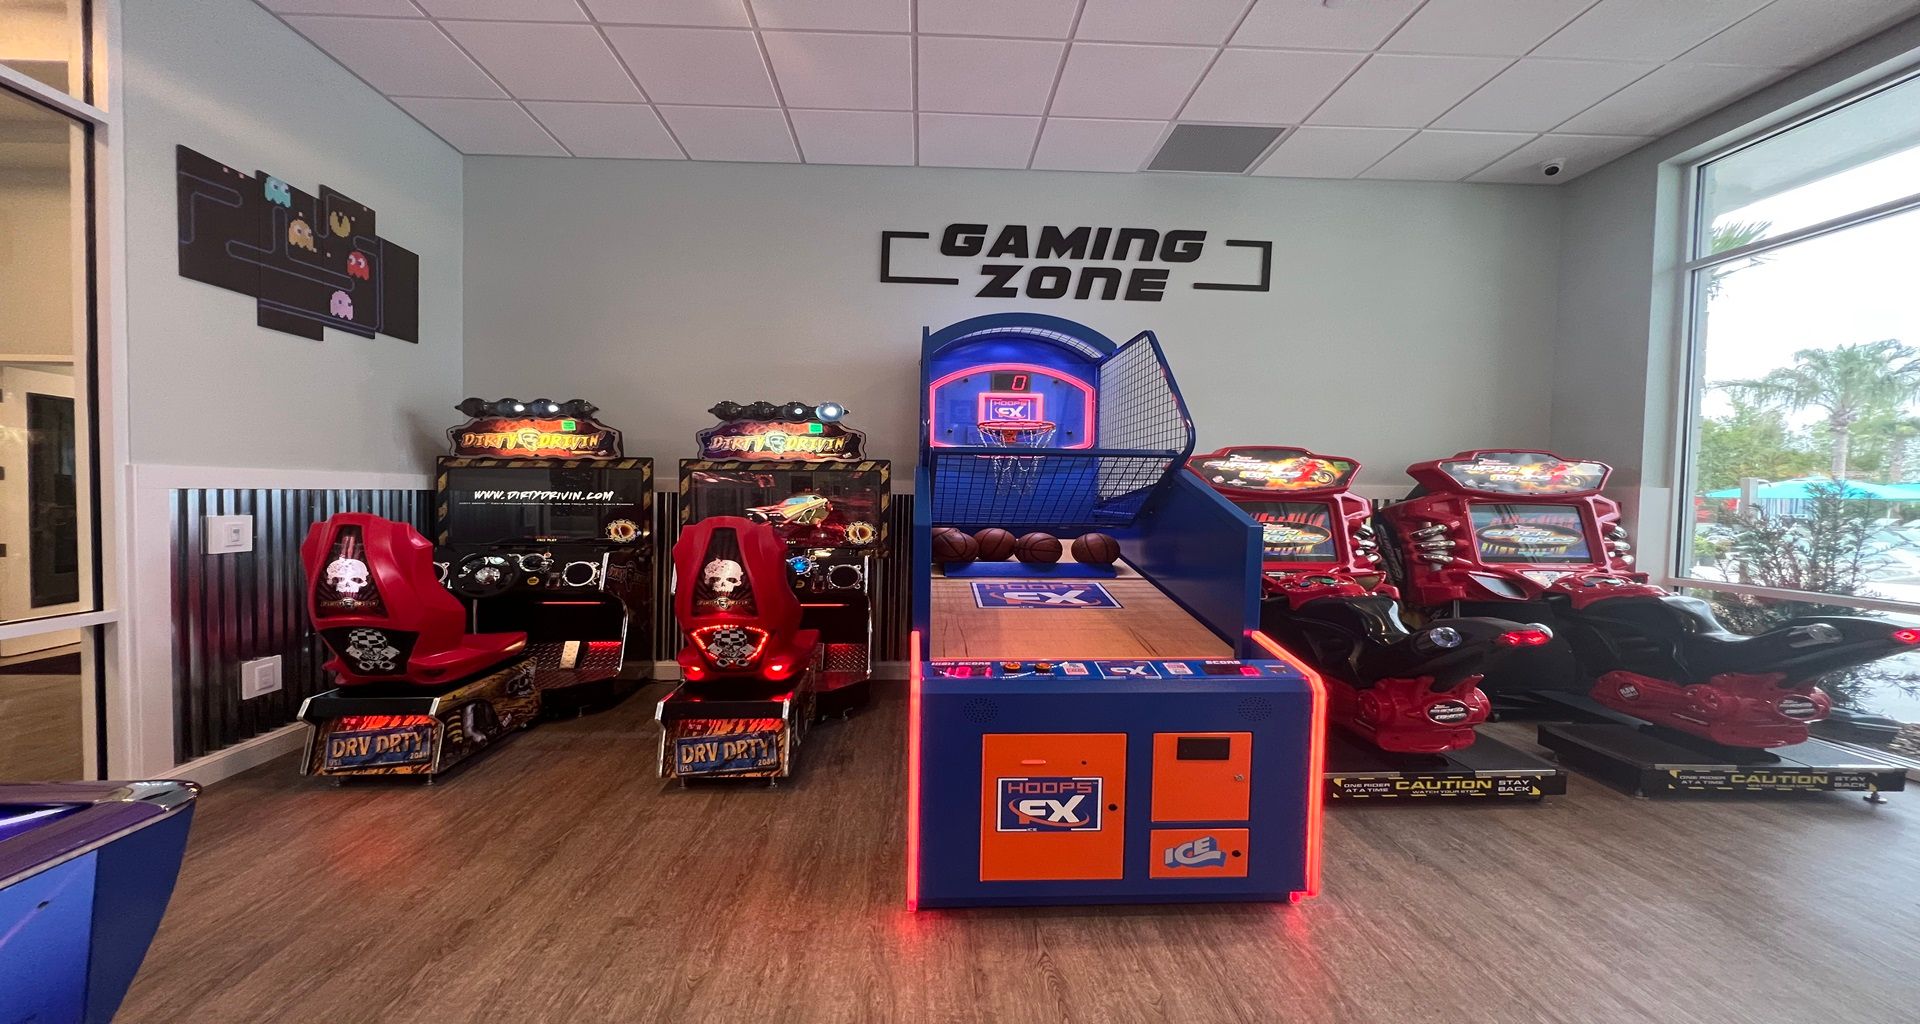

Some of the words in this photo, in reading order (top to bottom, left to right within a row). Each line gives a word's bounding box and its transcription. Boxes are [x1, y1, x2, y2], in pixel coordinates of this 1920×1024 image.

[940, 223, 1207, 263] GAMING
[975, 264, 1170, 302] ZONE
[1012, 375, 1028, 391] 0
[996, 405, 1024, 418] FX
[462, 431, 519, 449] DIRTY
[709, 434, 768, 452] DIRTY
[474, 490, 615, 501] WWW.DIRTYDRIVIN.COM
[1004, 589, 1088, 604] FX
[332, 736, 372, 759] DRV
[375, 731, 424, 754] DRTY
[681, 742, 719, 764] DRV
[722, 738, 770, 760] DRTY
[1007, 782, 1092, 794] HOOPS
[1395, 780, 1492, 790] CAUTION
[1731, 774, 1828, 784] CAUTION
[1019, 794, 1086, 825] FX
[1164, 836, 1223, 866] ICE
